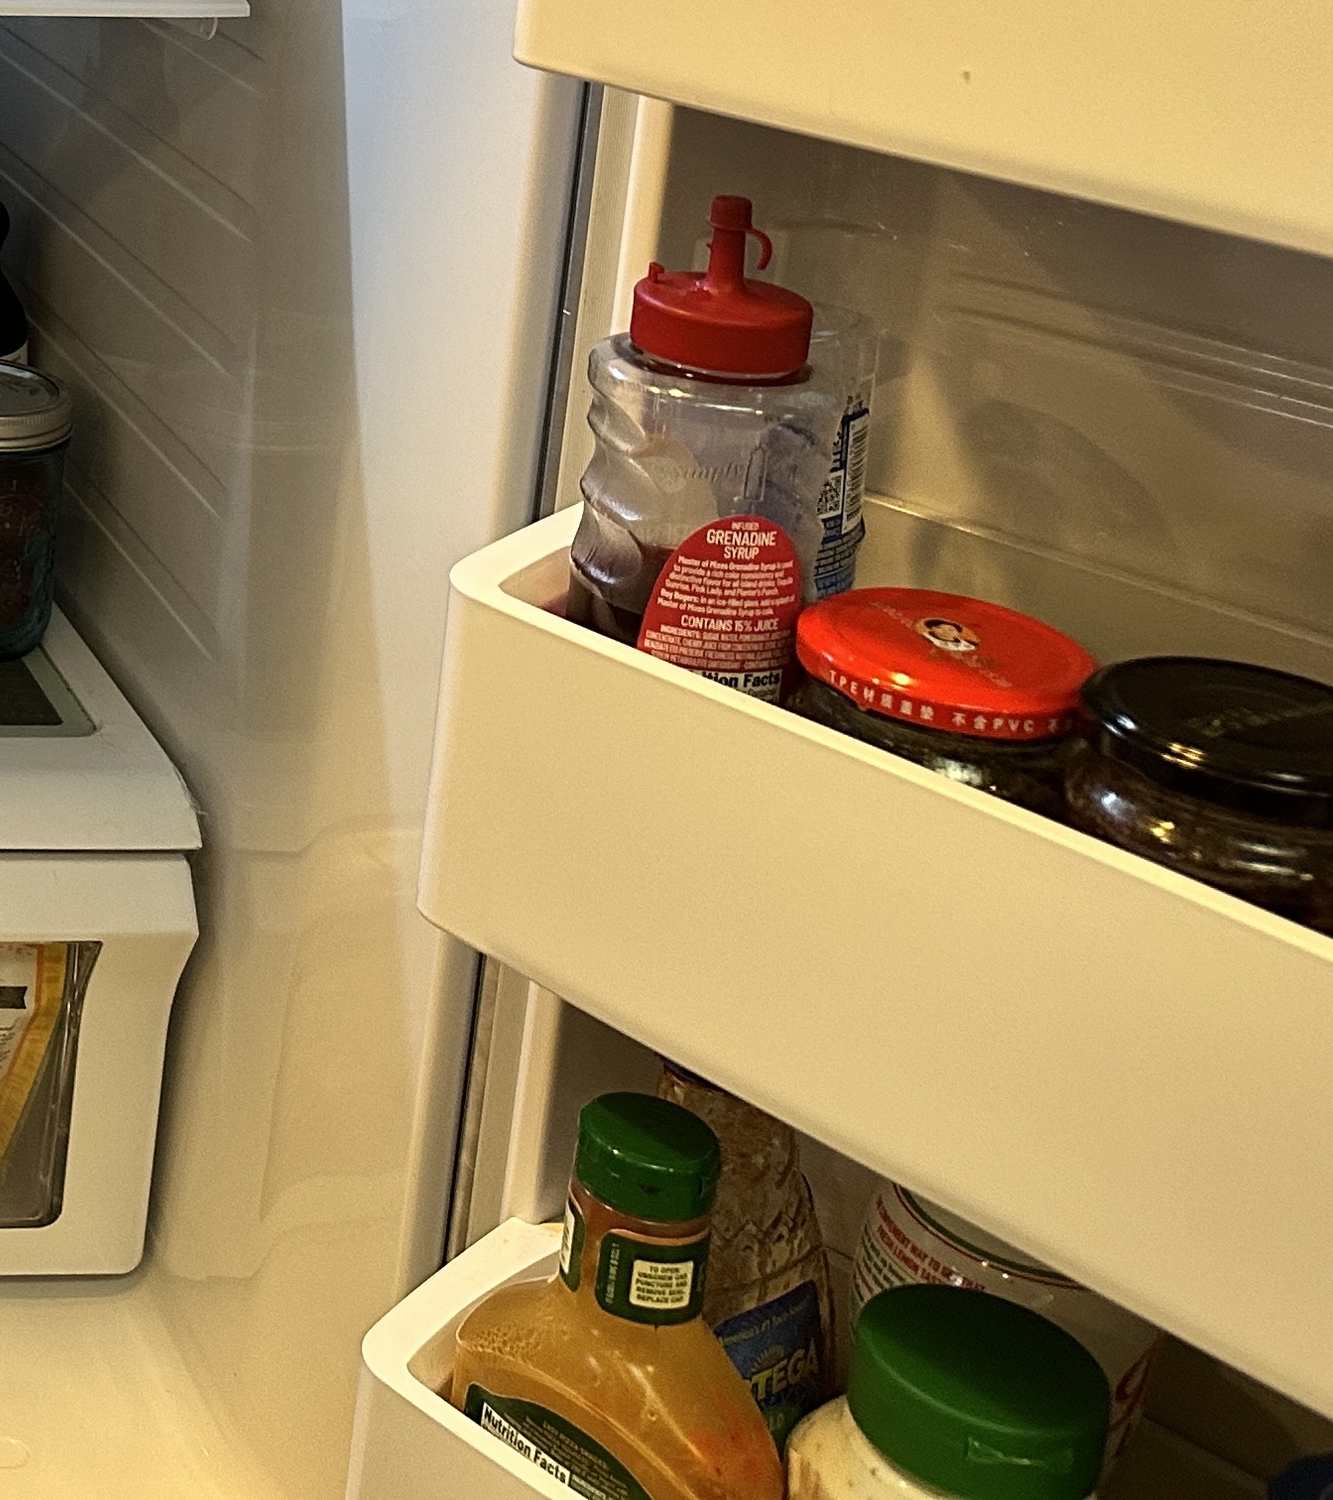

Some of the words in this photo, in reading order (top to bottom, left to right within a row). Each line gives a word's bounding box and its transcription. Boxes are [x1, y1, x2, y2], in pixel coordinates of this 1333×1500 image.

[731, 522, 759, 530] INFUSED
[706, 529, 777, 547] GRENADINE
[678, 556, 700, 567] Master
[724, 547, 760, 559] SYRUP
[691, 583, 706, 594] Pink
[681, 615, 732, 631] CONTAINS
[734, 619, 752, 632] 15%
[754, 618, 779, 632] JUICE
[743, 671, 780, 688] Facts
[649, 1265, 659, 1273] TO
[751, 1337, 819, 1402] TEGA
[483, 1405, 532, 1460] Nutrition
[532, 1452, 567, 1485] Facts
